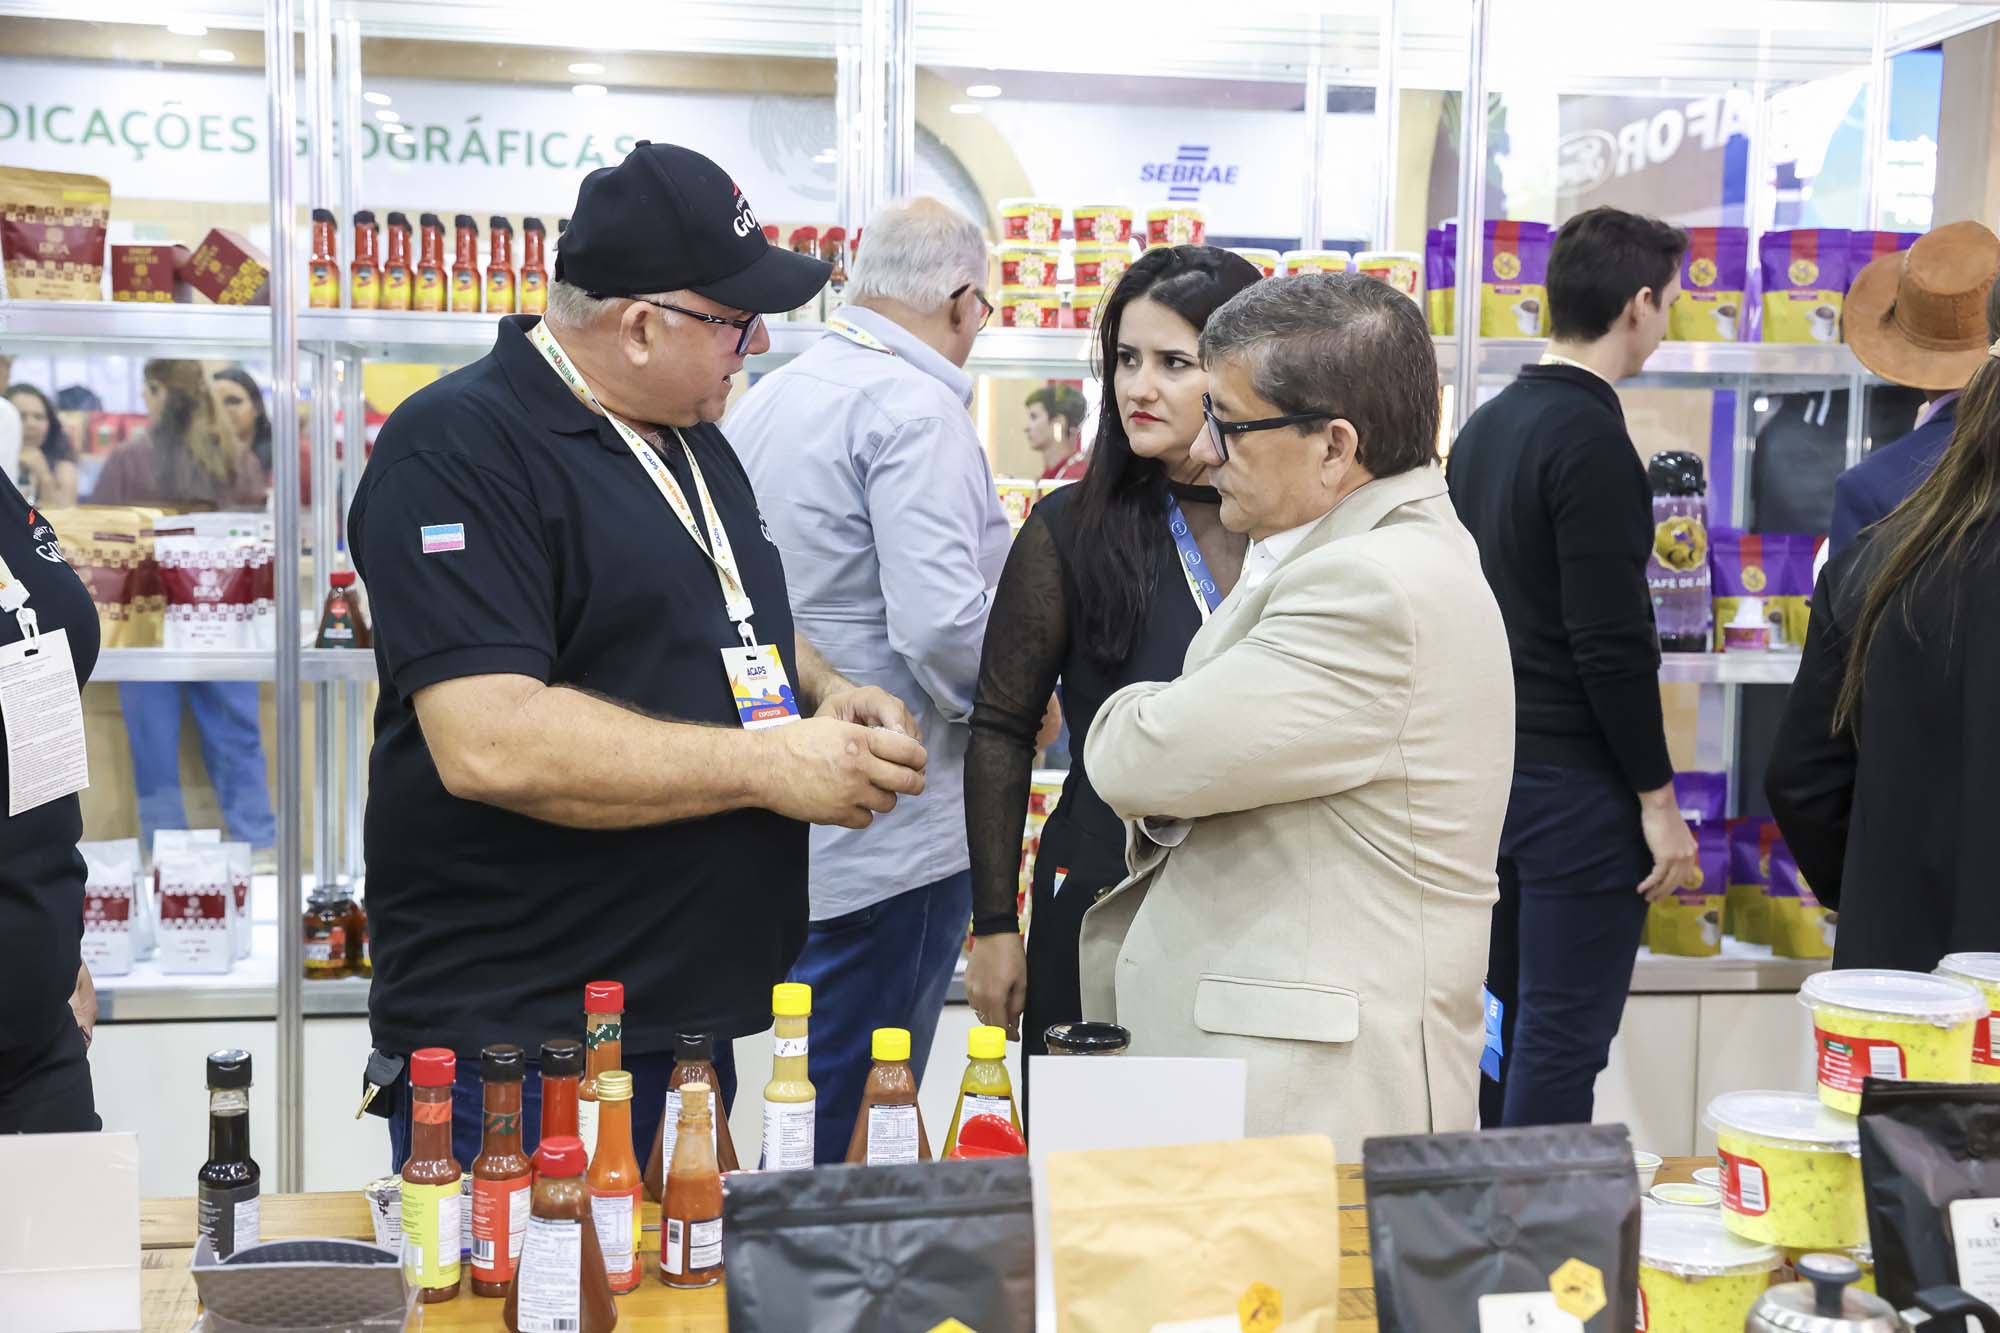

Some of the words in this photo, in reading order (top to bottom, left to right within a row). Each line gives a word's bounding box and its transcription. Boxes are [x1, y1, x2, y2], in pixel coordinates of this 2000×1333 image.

[1140, 163, 1239, 184] SEBRAE
[733, 208, 760, 238] GO
[642, 451, 659, 470] ACAPS
[747, 666, 767, 676] ACAPS
